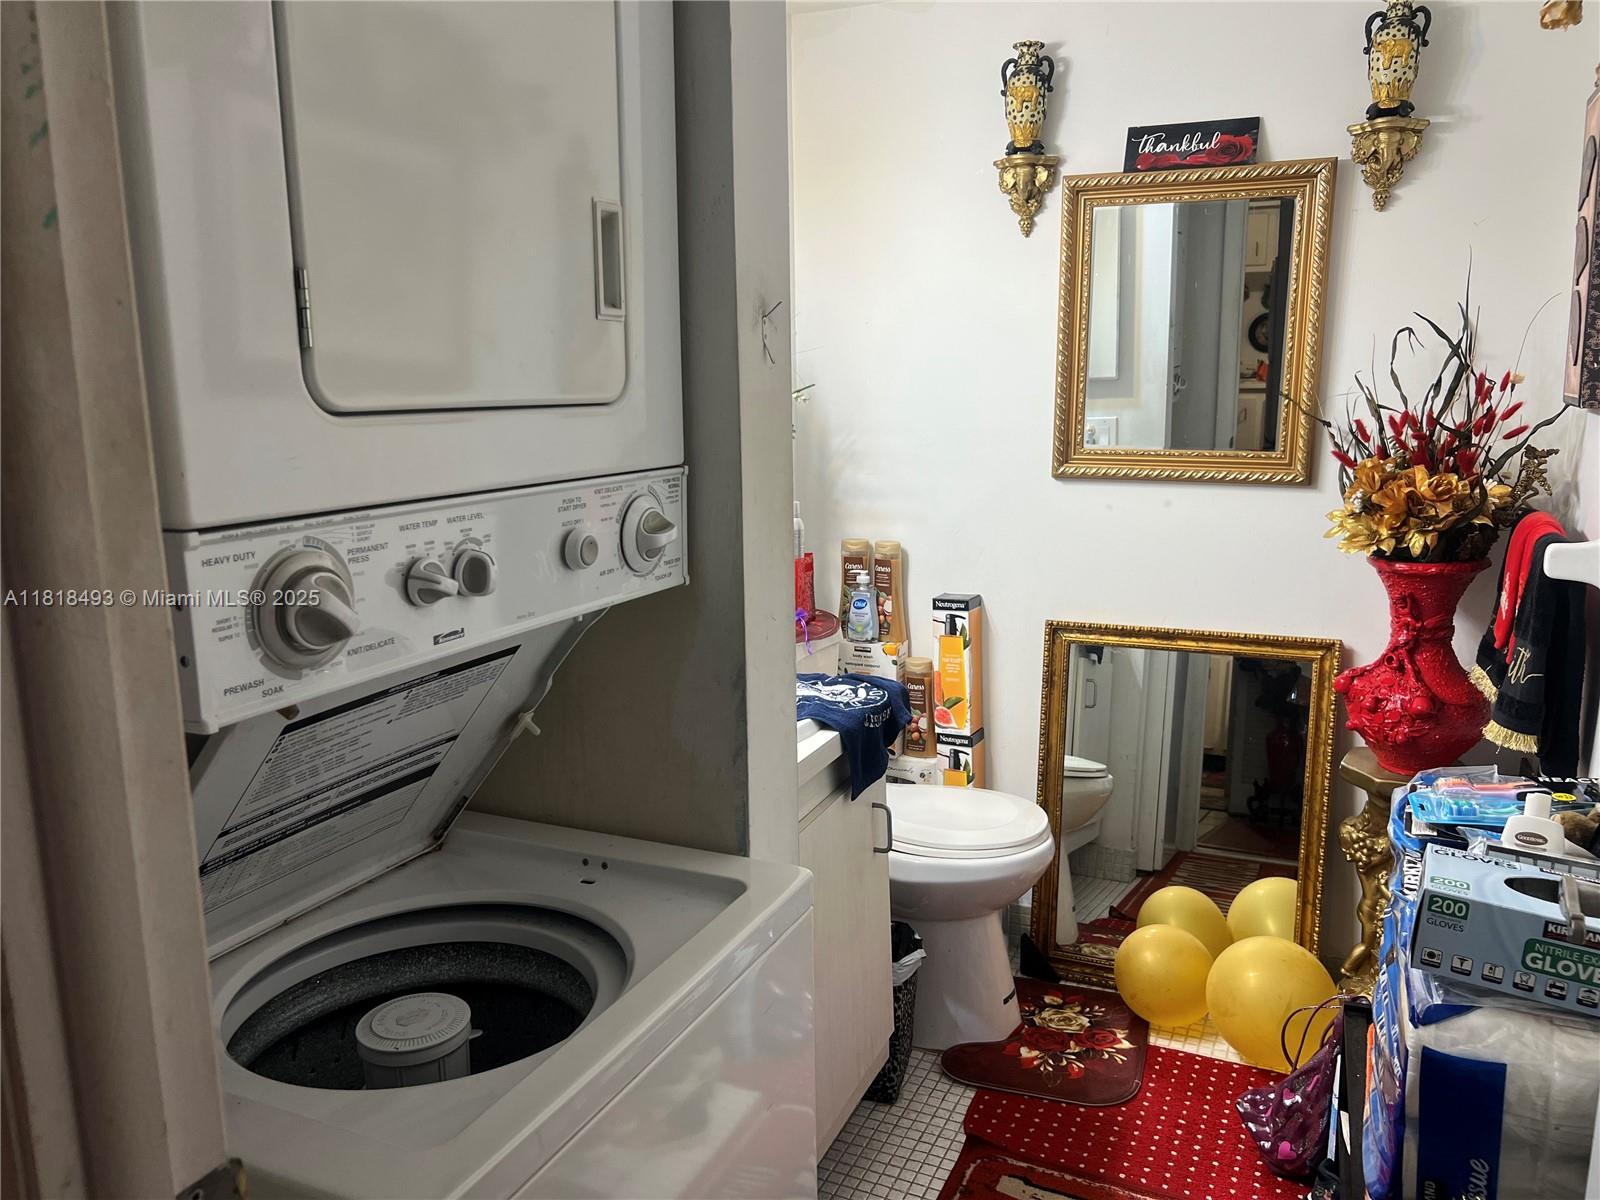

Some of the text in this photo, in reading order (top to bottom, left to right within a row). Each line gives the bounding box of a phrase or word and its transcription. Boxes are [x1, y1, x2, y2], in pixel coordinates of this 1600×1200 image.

[1131, 131, 1221, 154] thankful
[446, 512, 484, 524] WATER LEVEL
[399, 520, 438, 532] WATER TEMP
[347, 542, 389, 556] PERMANENT
[201, 555, 231, 568] HEAVY
[233, 551, 256, 562] DUTY
[347, 555, 370, 565] PRESS
[845, 562, 863, 570] Caress
[875, 564, 891, 572] Caress
[935, 600, 966, 609] Neutrogena
[347, 637, 395, 656] KNIT/DELICATE
[223, 678, 265, 697] PREWASH
[262, 685, 284, 698] SOAK
[907, 682, 925, 691] Caress
[940, 735, 969, 745] Neutrogena
[1434, 848, 1518, 870] GLOVES
[1433, 876, 1468, 889] 200
[1431, 897, 1467, 917] 200
[1426, 917, 1465, 933] GLOVES
[1535, 943, 1580, 961] NITRILE
